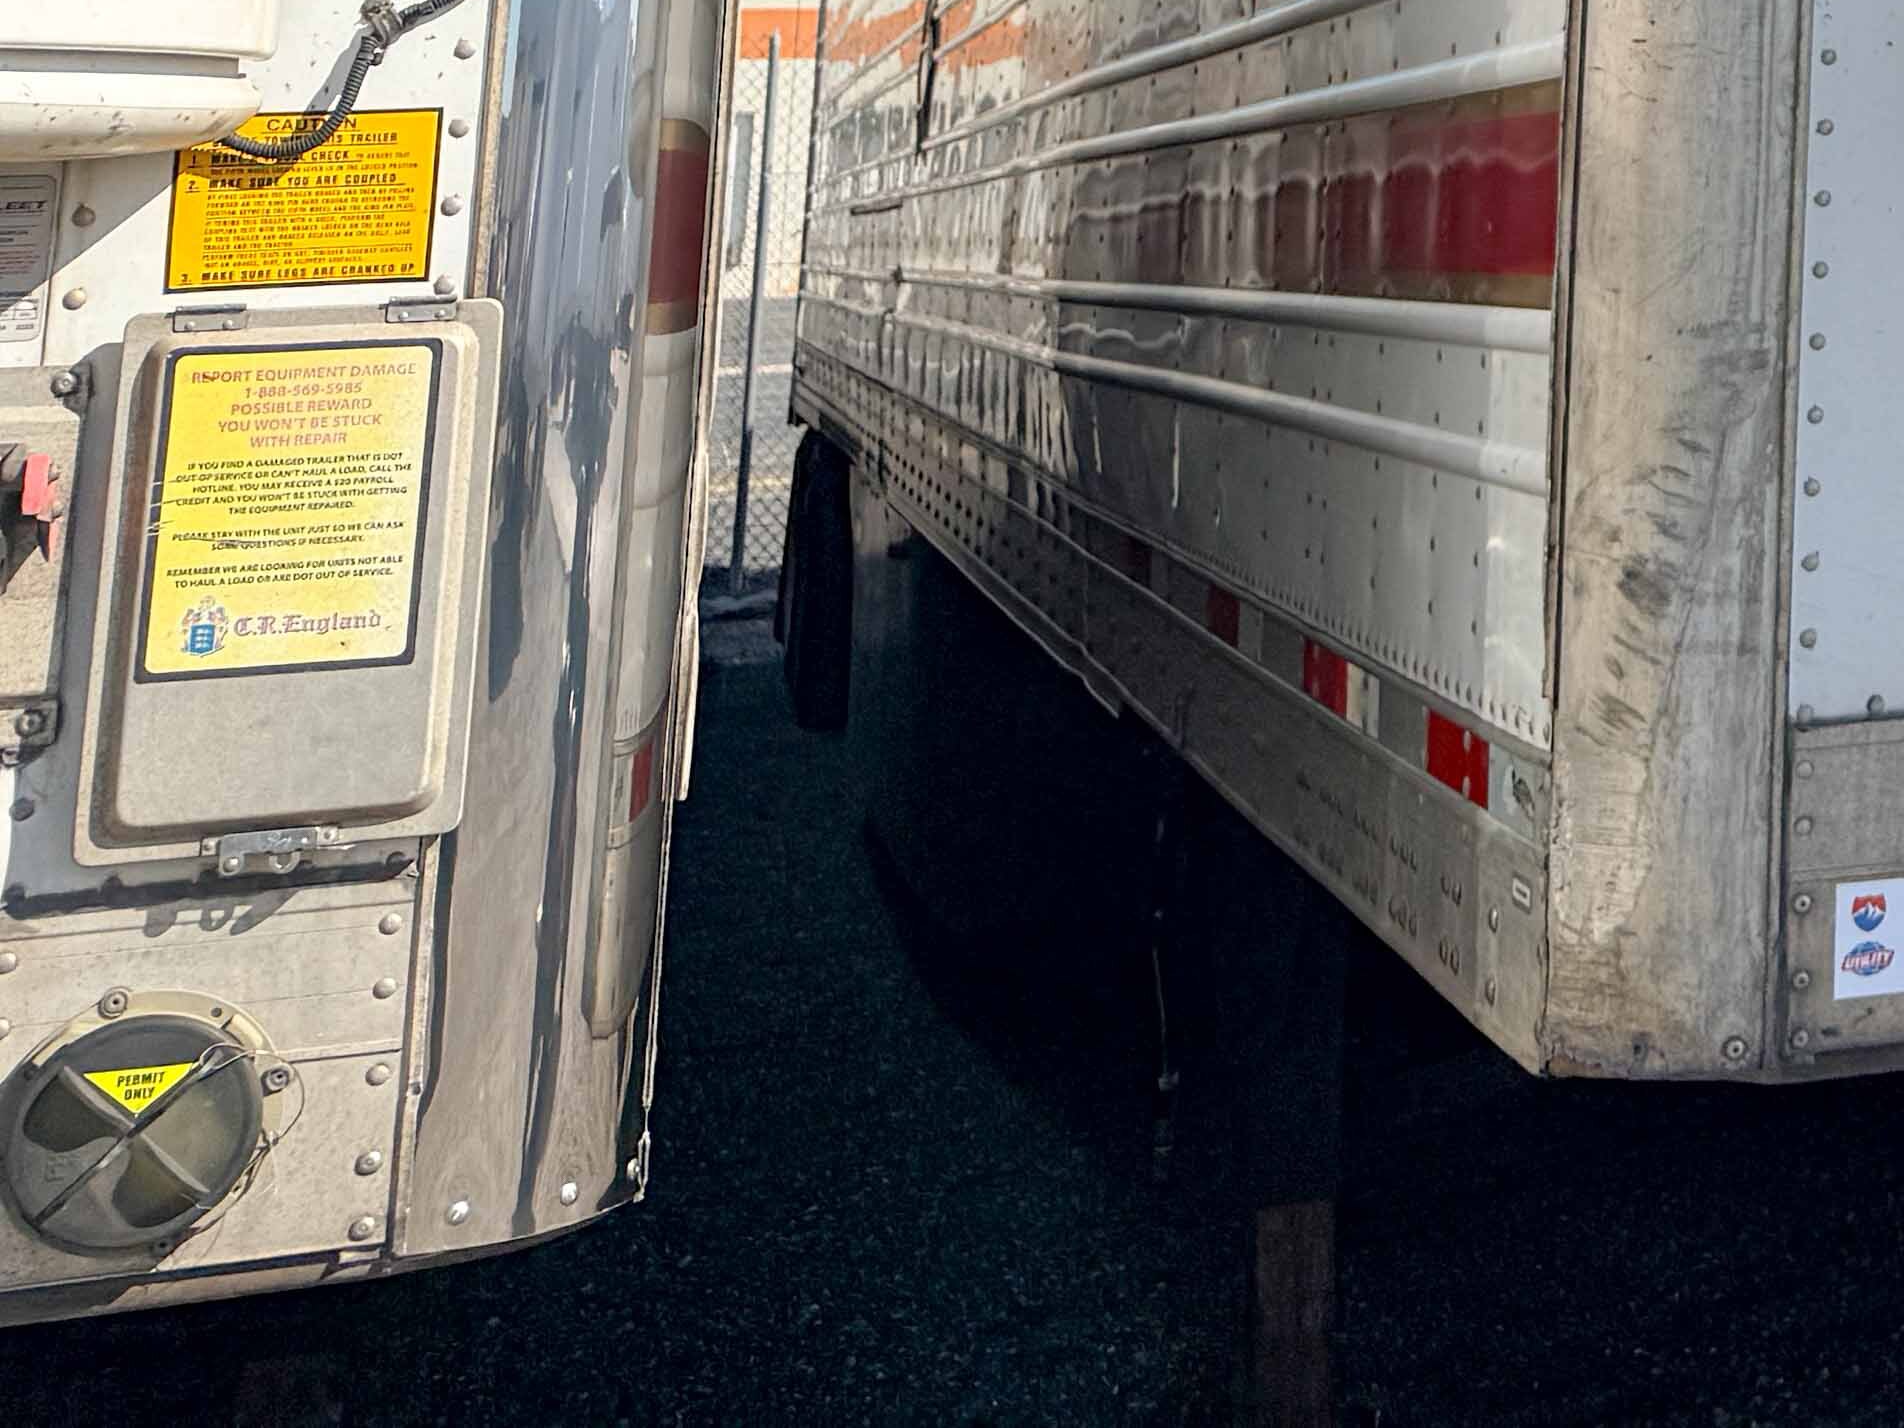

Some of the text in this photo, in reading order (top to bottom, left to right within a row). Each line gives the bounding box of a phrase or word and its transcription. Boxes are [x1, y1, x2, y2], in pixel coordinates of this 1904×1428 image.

[267, 118, 357, 131] CAUTN
[351, 132, 398, 142] TRAILER
[312, 150, 349, 161] CHECK
[209, 177, 242, 188] MAKE
[249, 176, 279, 187] SURE
[288, 175, 309, 186] YOU
[316, 174, 338, 184] ARE
[344, 173, 397, 183] COUPLED
[202, 270, 234, 281] MAKE
[241, 269, 271, 280] SURE
[278, 268, 307, 278] LEGS
[313, 266, 335, 277] ARE
[341, 264, 395, 275] CRANKED
[400, 263, 414, 273] UP
[191, 362, 417, 384] REPORT EQUIPMENT DAMAGE
[230, 398, 372, 415] POSSIBLE REWARD
[218, 413, 382, 433] YOU WON'T BE STUCK
[250, 432, 347, 449] WITH REPAIR
[198, 462, 219, 470] YOU
[221, 460, 244, 469] FIND
[255, 457, 304, 467] DAMAGED
[307, 455, 345, 464] TRAILER
[347, 453, 371, 462] THAT
[373, 453, 381, 461] IS
[176, 474, 197, 482] OUT
[199, 473, 212, 481] OF
[214, 471, 253, 481] SERVICE
[271, 469, 300, 478] CAN'T
[302, 468, 328, 476] HAUL
[330, 467, 337, 475] A
[369, 464, 391, 473] CALL
[395, 463, 412, 472] THE
[240, 483, 260, 491] YOU
[262, 482, 282, 490] MAY
[284, 479, 323, 488] RECEIVE
[353, 476, 394, 485] PAYROLL
[176, 486, 408, 506] CREDIT AND YOU WON'T BE STUCK WITH GETTING
[249, 503, 305, 514] EQUIPMENT
[211, 531, 233, 539] STAY
[235, 529, 261, 537] WITH
[263, 528, 281, 536] THE
[283, 526, 305, 535] UNIT
[307, 525, 330, 534] JUST
[333, 524, 345, 532] SO
[347, 523, 362, 531] WE
[364, 522, 384, 530] CAN
[240, 538, 296, 549] QUESTIONS
[166, 555, 403, 576] REMEMBER WE ARE LOOKING FOR UNITS NOT ABLE
[175, 580, 188, 588] TO
[190, 579, 216, 587] HAUL
[228, 576, 254, 585] LOAD
[256, 575, 271, 583] OR
[272, 574, 291, 582] ARE
[315, 571, 335, 579] OUT
[337, 570, 350, 578] OF
[1840, 948, 1895, 974] UTILITY
[117, 1071, 165, 1087] PERMIT
[124, 1087, 155, 1101] ONLY
